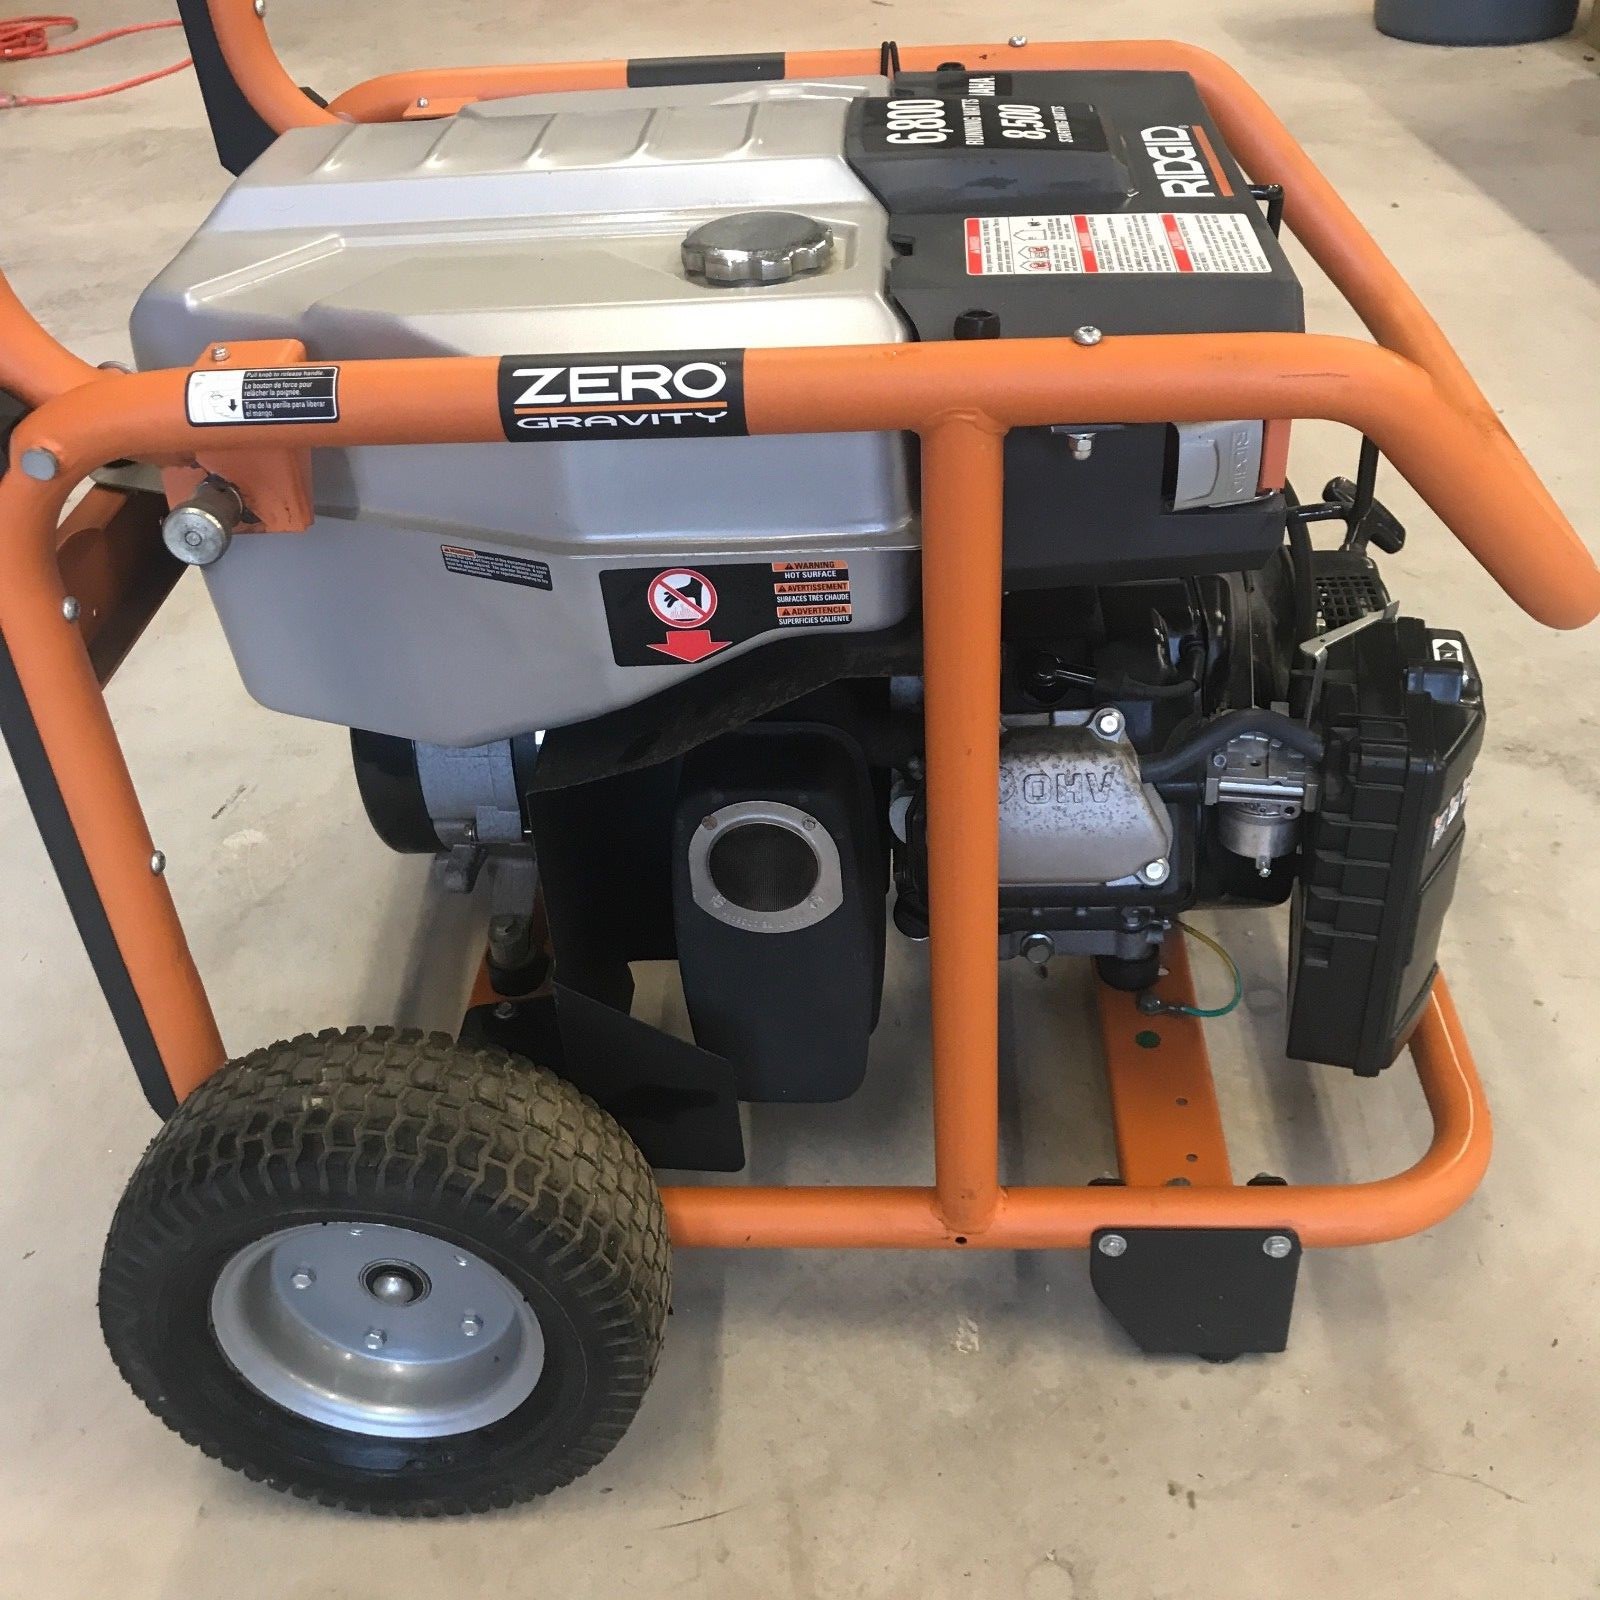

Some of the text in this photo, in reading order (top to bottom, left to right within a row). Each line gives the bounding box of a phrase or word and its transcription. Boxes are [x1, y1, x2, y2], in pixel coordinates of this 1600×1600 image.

[886, 99, 954, 144] 6,800
[961, 98, 985, 146] RUNNING WATTS
[998, 104, 1051, 140] 8,500
[1050, 105, 1074, 143] STARTING WATTS
[1140, 125, 1216, 198] RIDGID
[516, 411, 728, 429] GRAVITY
[795, 561, 835, 569] WARNING
[784, 570, 837, 579] HOT SURFACE
[788, 582, 847, 592] AVERTISSEMENT
[777, 595, 808, 603] SURFACES
[779, 615, 850, 625] SUPERFICIES CALIENTE
[792, 606, 847, 616] ADVERTENCIA
[1023, 771, 1115, 805] OHV
